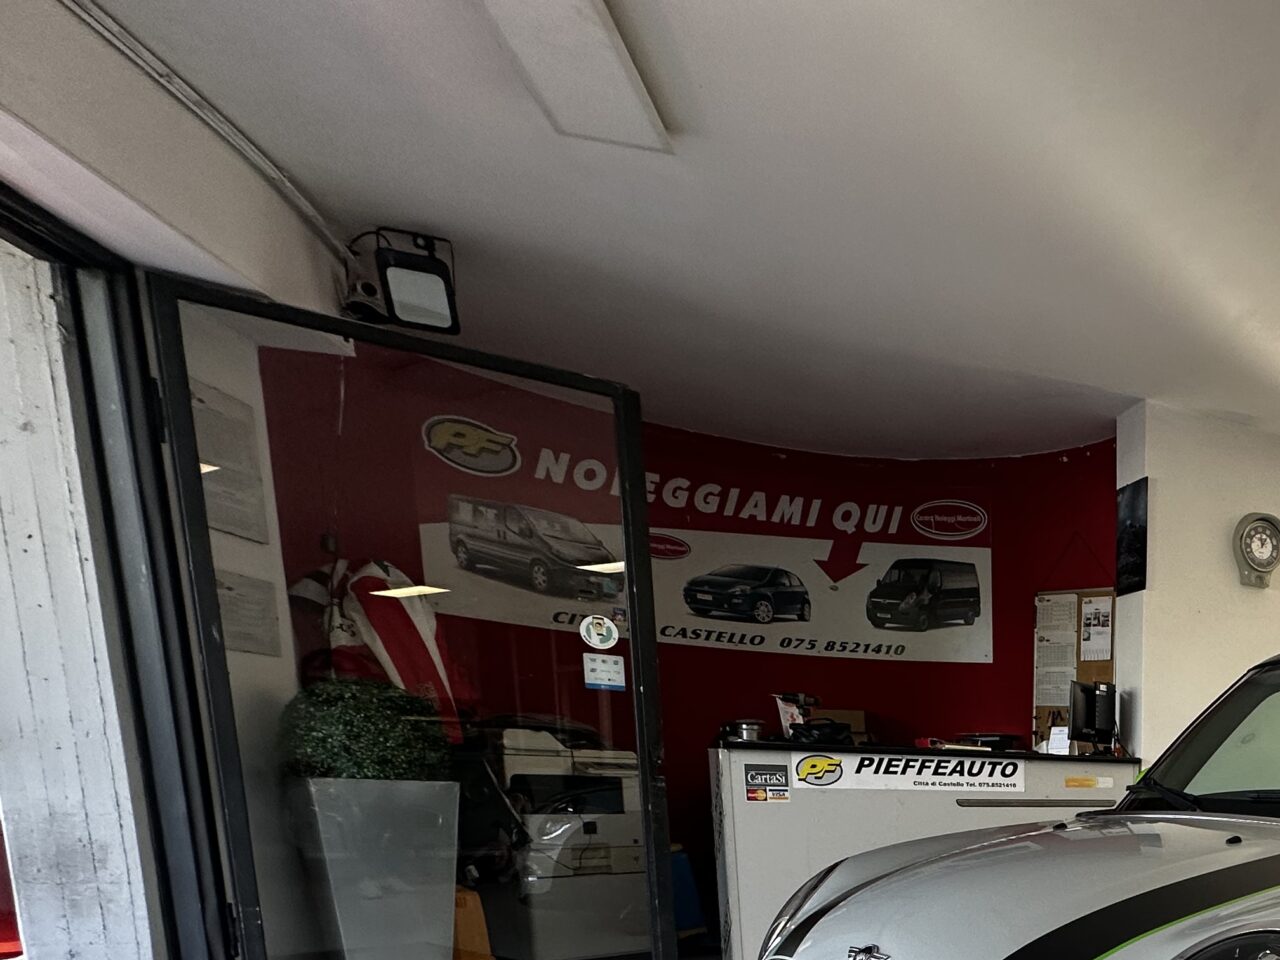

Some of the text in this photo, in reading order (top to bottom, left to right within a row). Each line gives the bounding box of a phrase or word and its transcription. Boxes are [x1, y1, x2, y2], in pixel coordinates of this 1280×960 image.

[832, 501, 904, 535] QUI
[659, 625, 907, 657] CASTELLO 075 8521410
[854, 756, 1019, 779] PIEFFEAUTO
